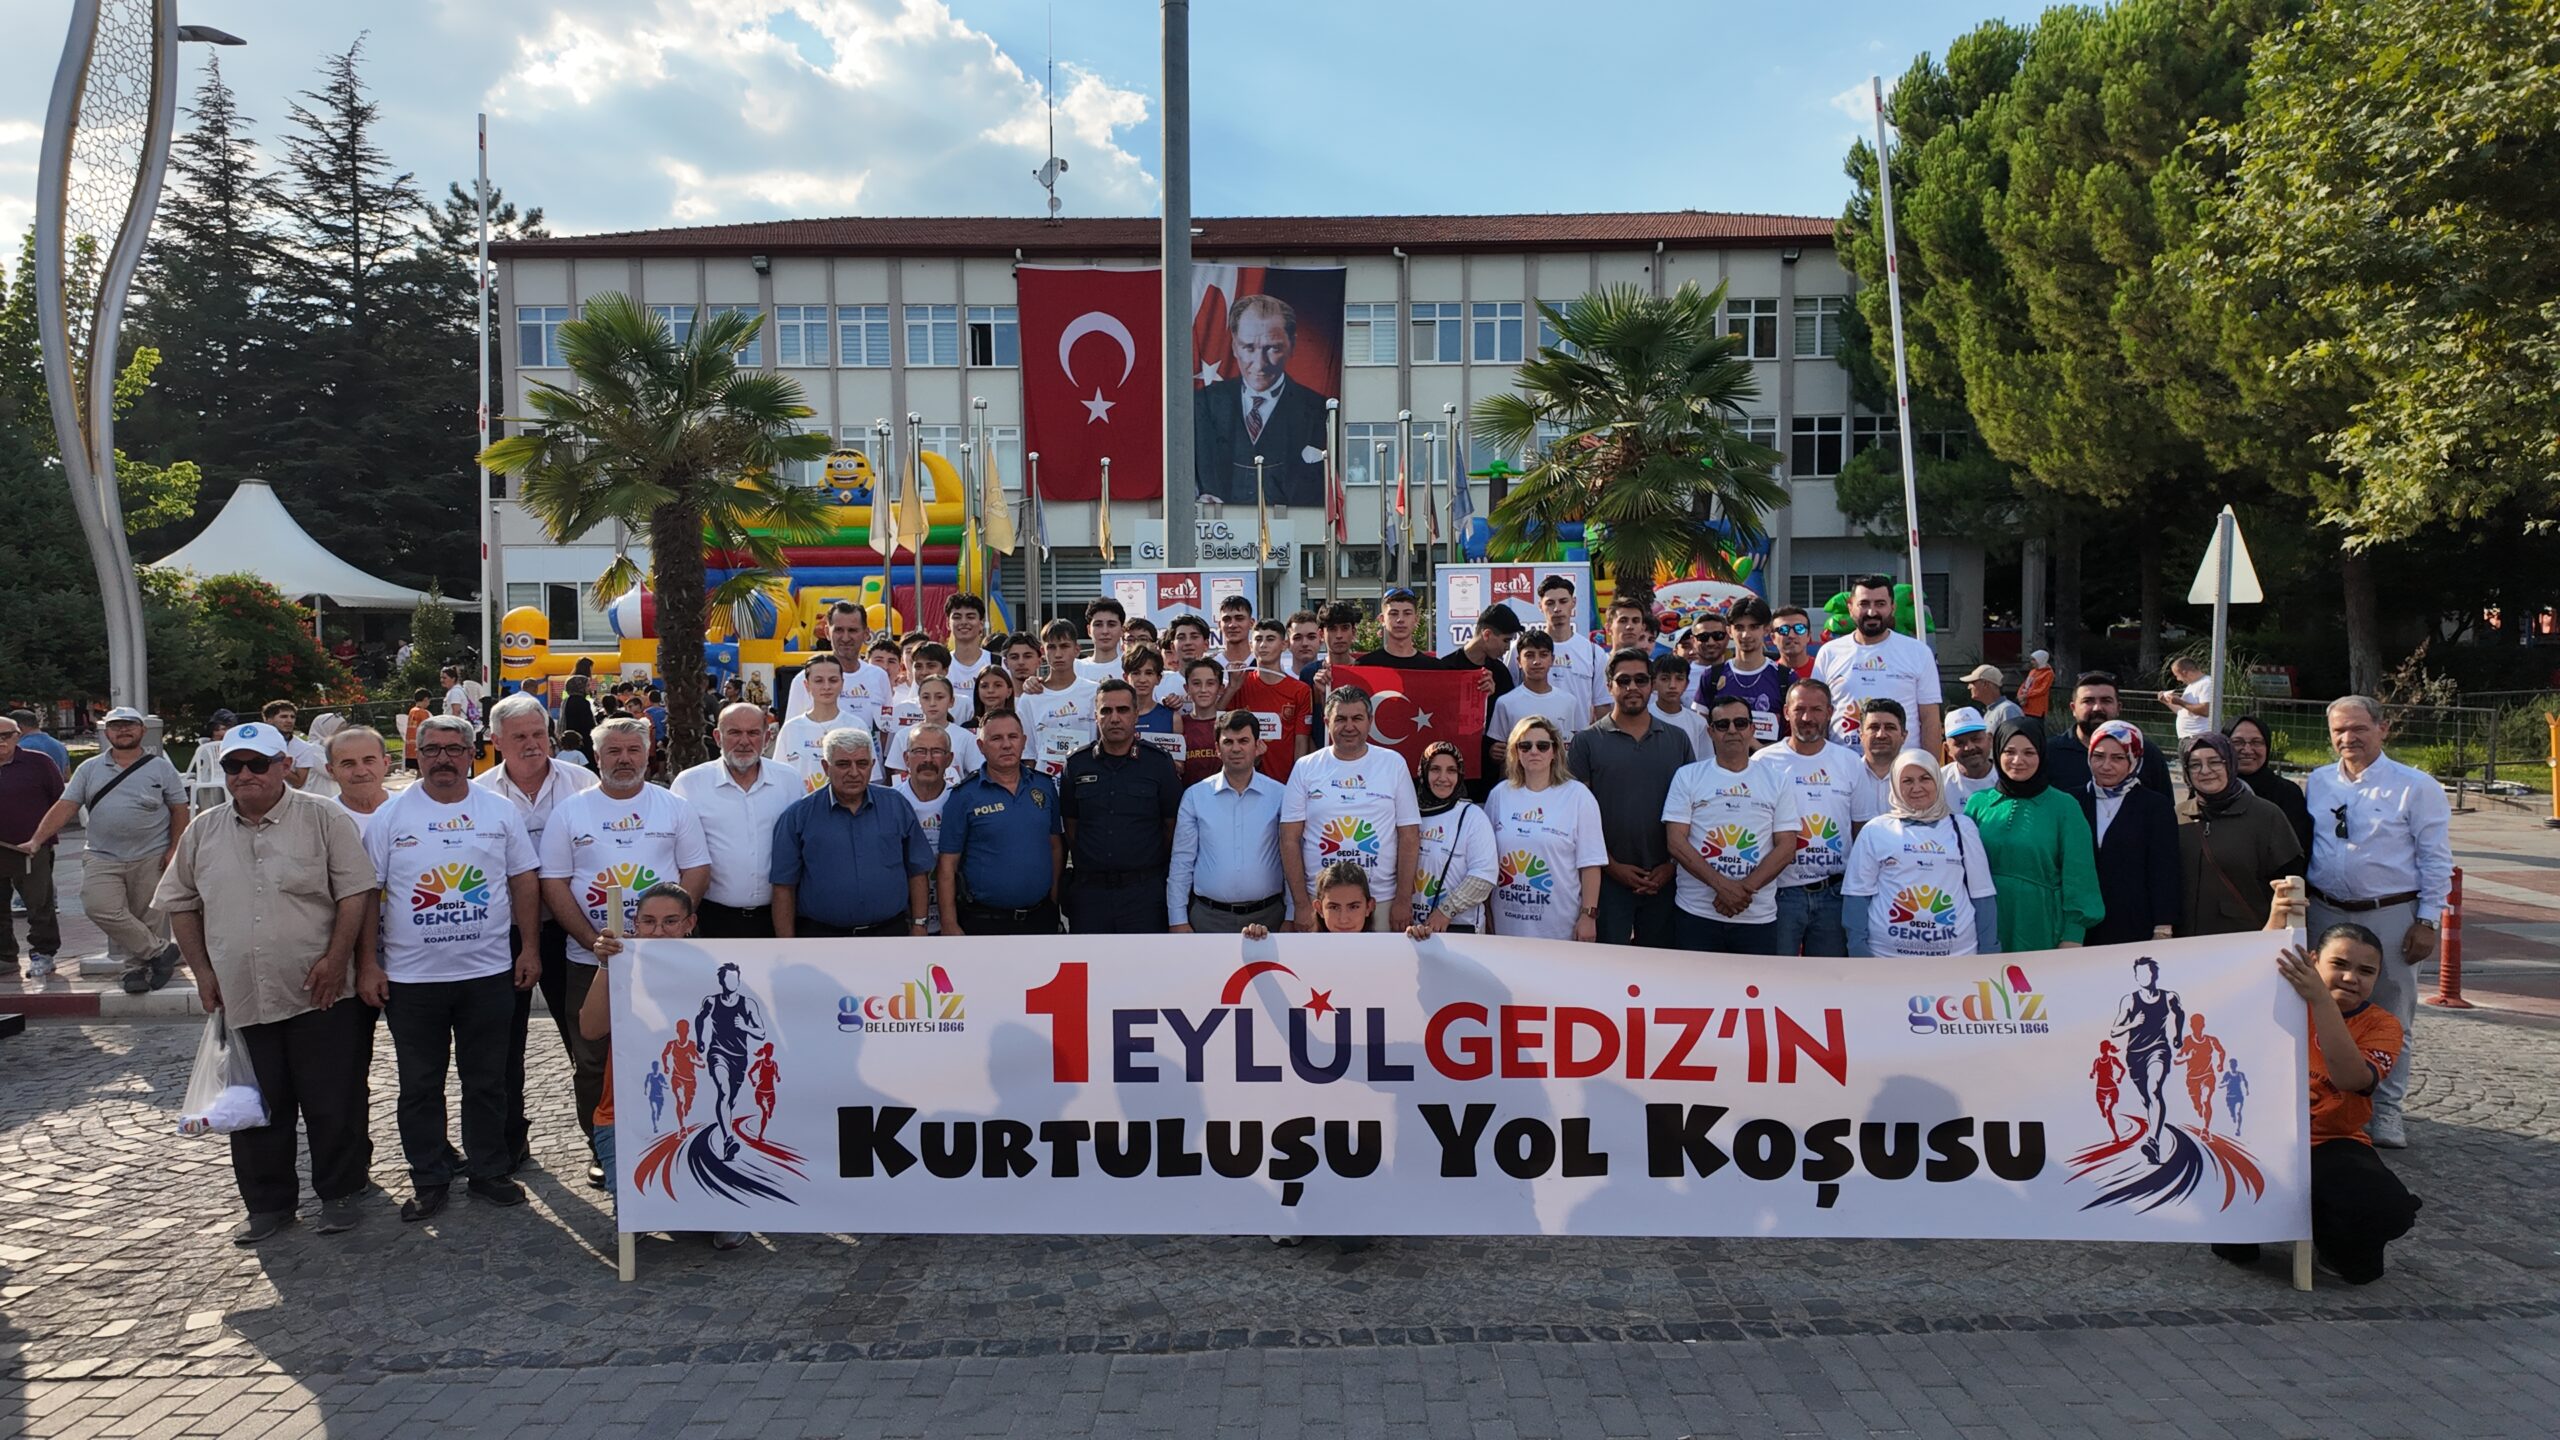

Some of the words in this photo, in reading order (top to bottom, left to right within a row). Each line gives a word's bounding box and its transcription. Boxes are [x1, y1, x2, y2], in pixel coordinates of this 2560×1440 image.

[1196, 521, 1234, 540] T.C.
[1056, 741, 1070, 751] 166
[1337, 849, 1361, 857] GEDİZ
[1806, 846, 1829, 854] GEDİZ
[1718, 856, 1742, 864] GEDİZ
[1510, 883, 1532, 892] GEDİZ
[1498, 890, 1552, 906] GENÇLİK
[436, 899, 467, 911] GEDİZ
[412, 906, 489, 926] GENÇLİK
[1909, 920, 1937, 929] GEDİZ
[423, 932, 481, 944] KOMPLEKSİ
[1888, 925, 1958, 944] GENÇLİK
[865, 1022, 936, 1033] BELEDİYESİ
[938, 1022, 965, 1033] 1866
[1025, 962, 1089, 1083] 1
[1940, 1022, 2018, 1035] BELEDİYESİ
[2020, 1022, 2049, 1034] 1866
